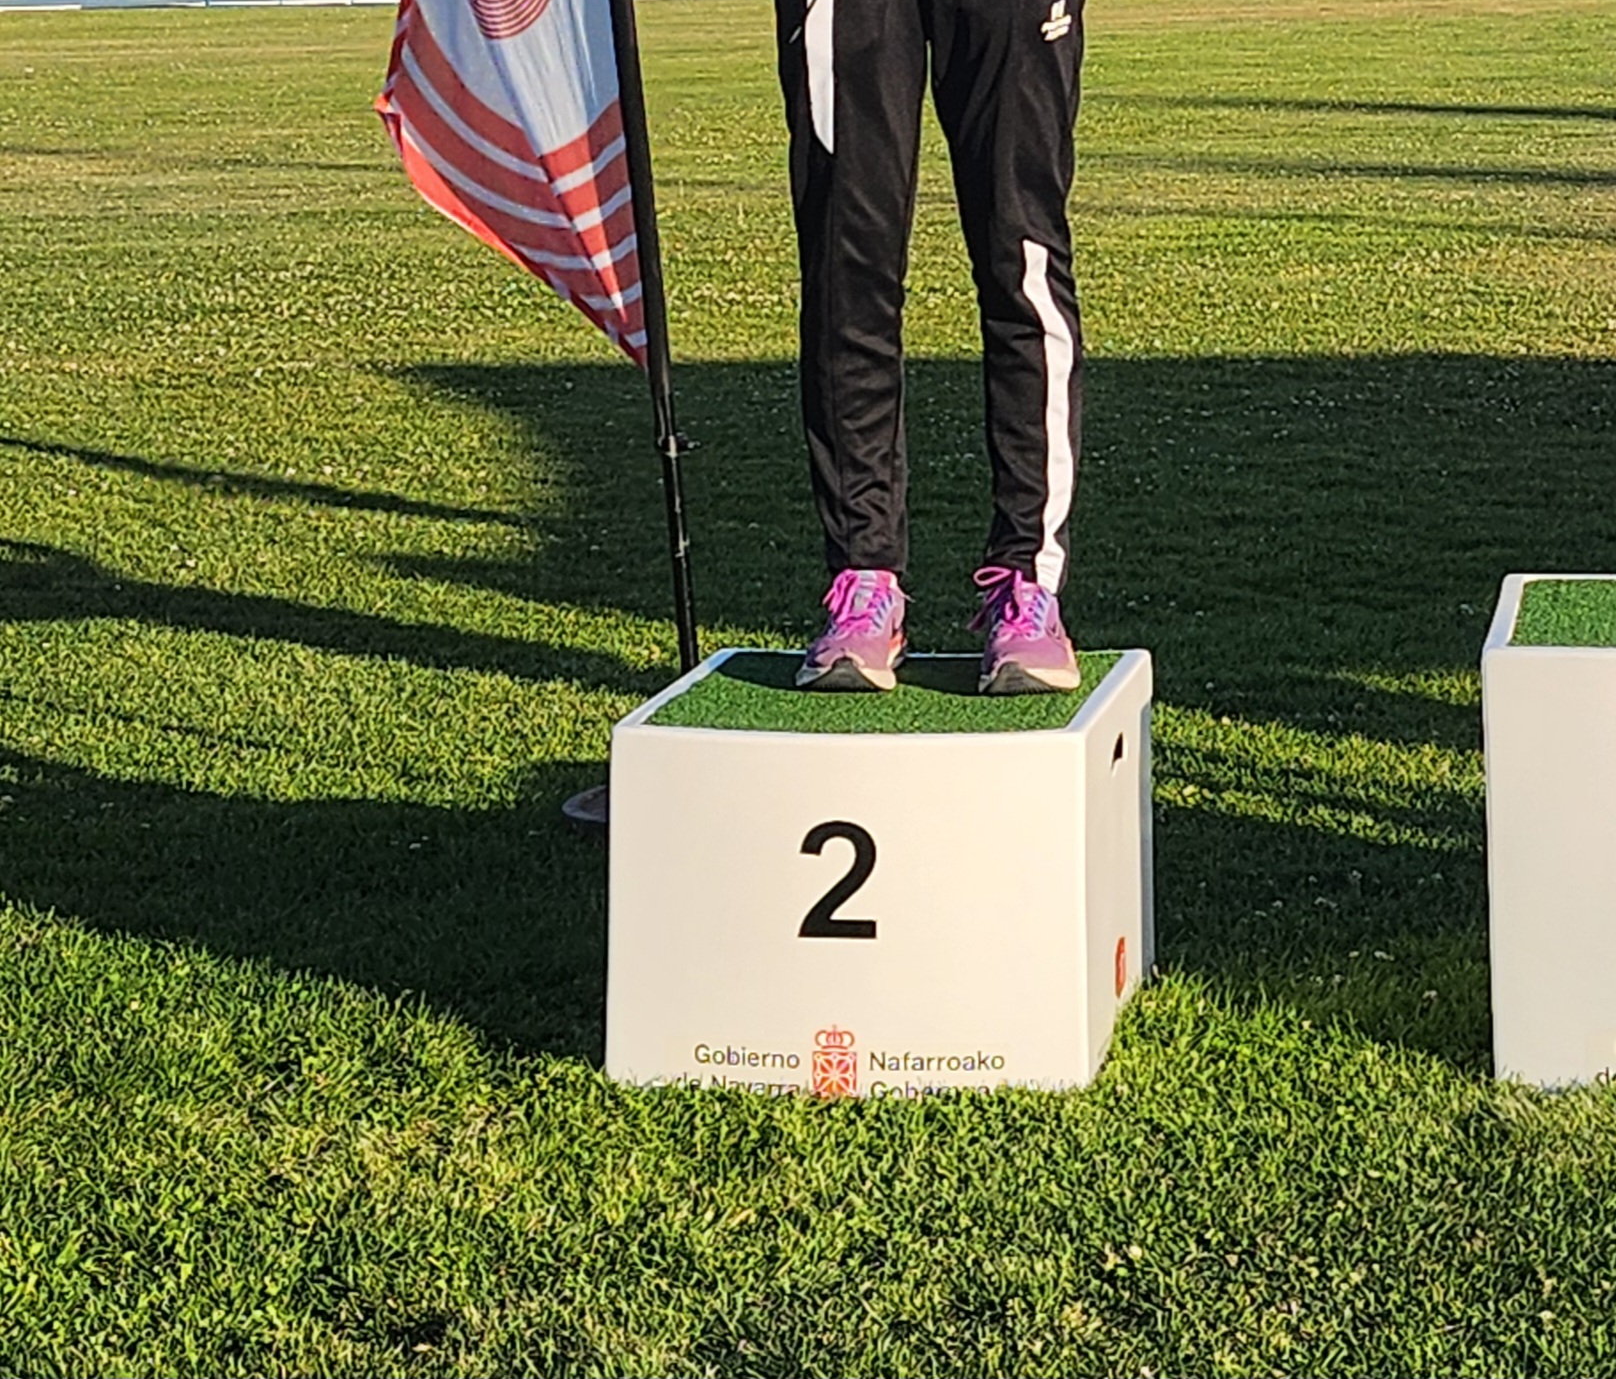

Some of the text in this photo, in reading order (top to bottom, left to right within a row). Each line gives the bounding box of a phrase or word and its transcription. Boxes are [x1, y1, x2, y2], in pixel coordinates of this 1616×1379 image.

[798, 819, 878, 939] 2
[694, 1043, 801, 1069] Gobierno
[869, 1051, 1005, 1071] Nafarroako
